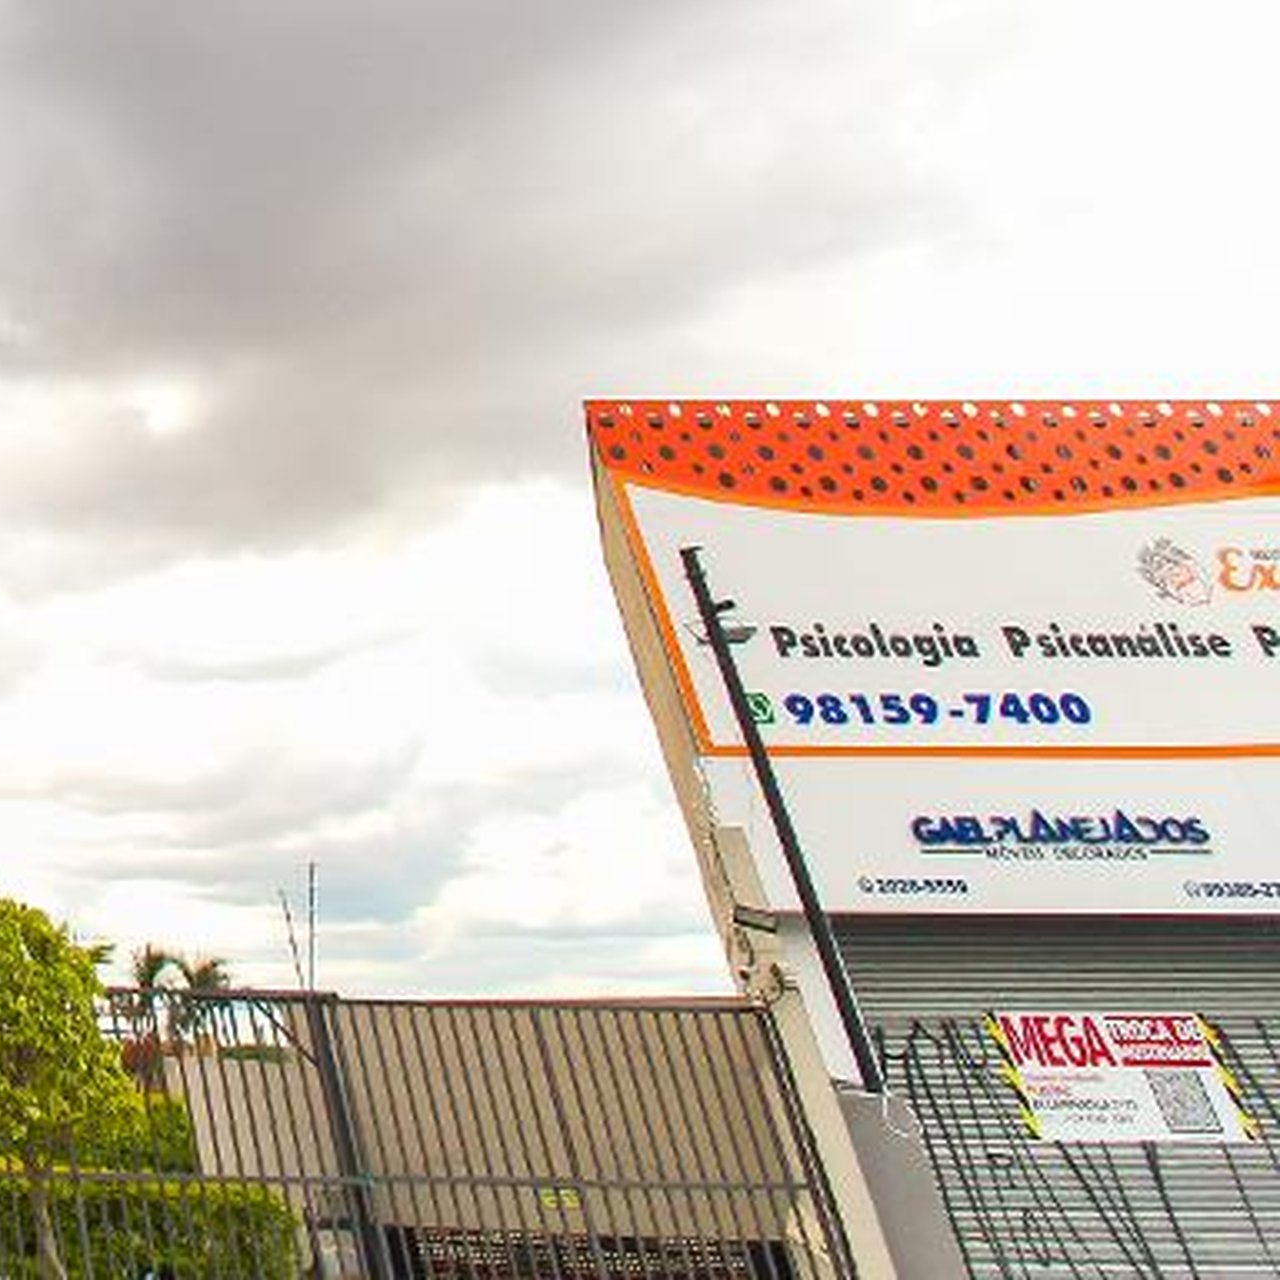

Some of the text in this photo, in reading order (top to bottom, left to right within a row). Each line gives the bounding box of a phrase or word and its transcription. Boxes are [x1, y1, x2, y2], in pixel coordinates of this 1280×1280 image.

[770, 623, 980, 666] Psicologia
[1002, 623, 1232, 658] Psicanálise
[784, 693, 1092, 724] 98159-7400
[999, 1016, 1117, 1067] MEGA
